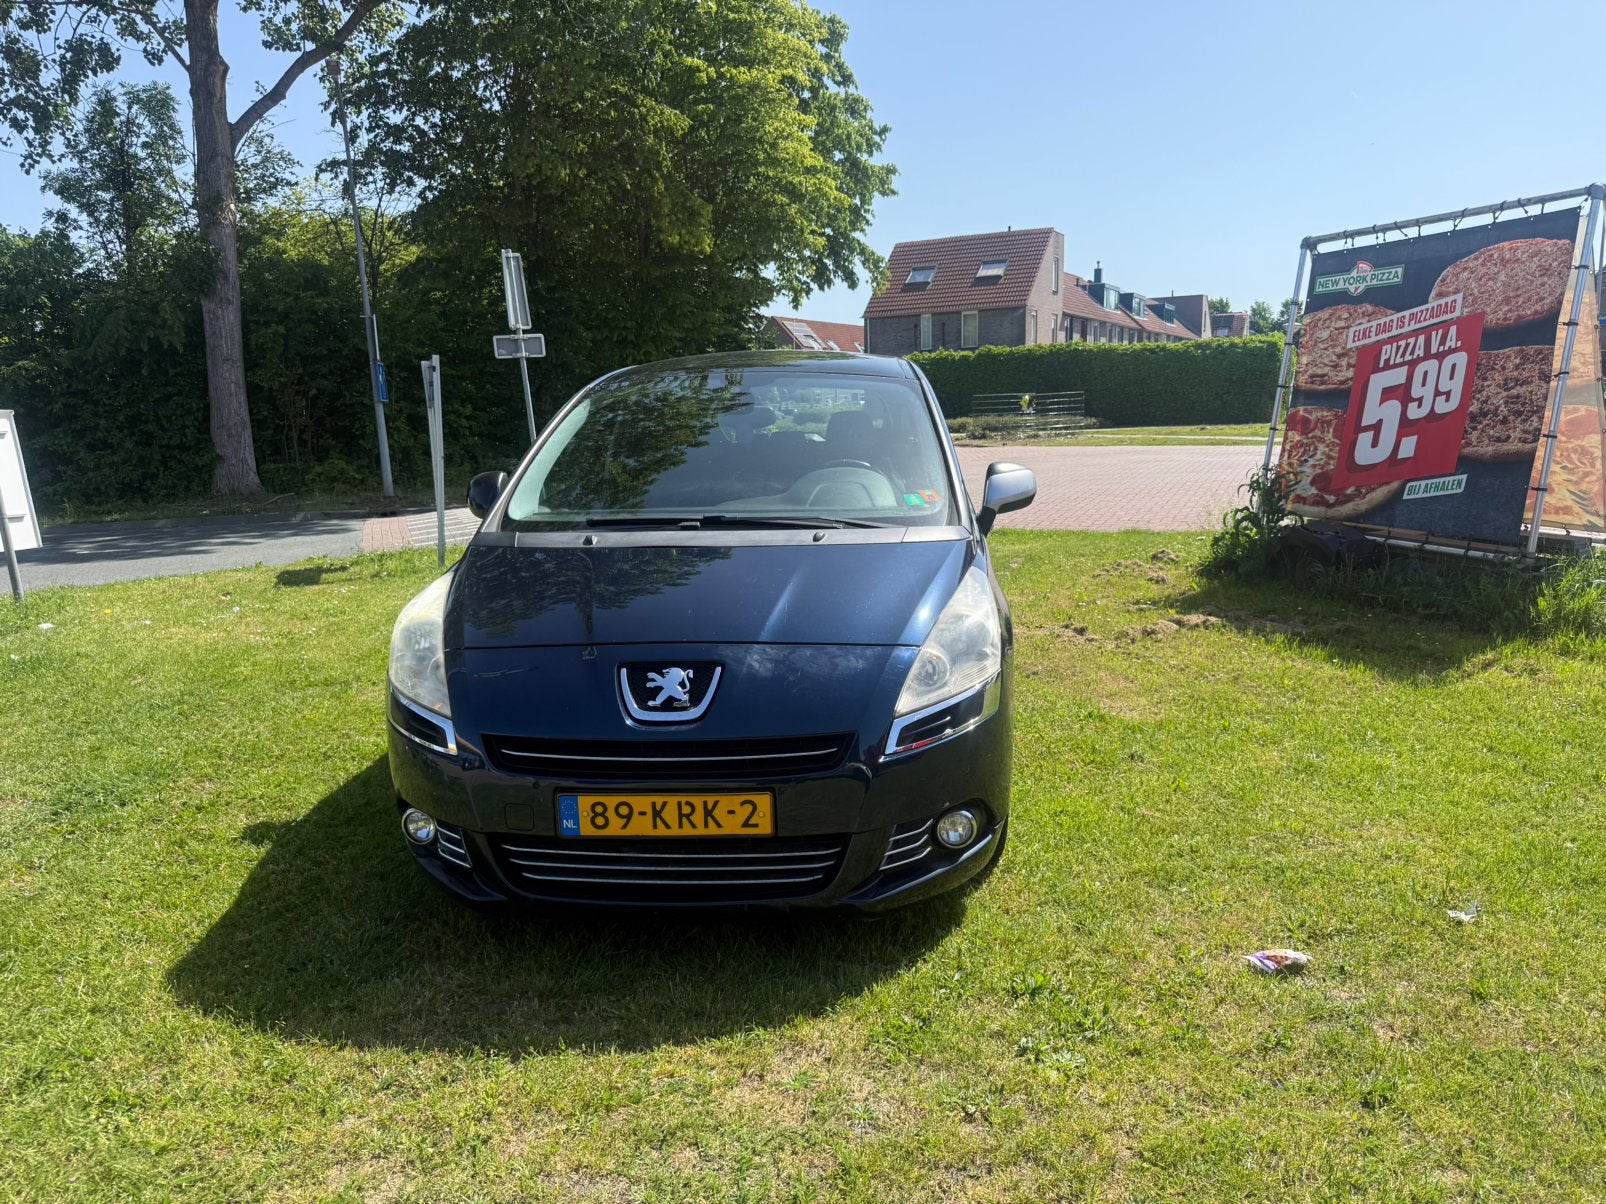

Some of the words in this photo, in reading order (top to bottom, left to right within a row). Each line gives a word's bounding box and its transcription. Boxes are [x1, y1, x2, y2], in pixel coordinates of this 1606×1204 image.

[1317, 277, 1341, 290] NEW
[1341, 274, 1369, 287] YORK
[1370, 270, 1400, 284] PIZZA
[1352, 325, 1373, 342] ELKE
[1375, 321, 1394, 337] DAG
[1395, 315, 1406, 331] IS
[1407, 299, 1457, 327] PIZZADAG
[1379, 334, 1425, 368] PIZZA
[1431, 325, 1462, 354] V.A.
[1407, 483, 1421, 496] BIJ
[1422, 478, 1464, 494] AFHALEN
[563, 819, 578, 829] NL
[589, 800, 760, 830] 89-KRK-2
